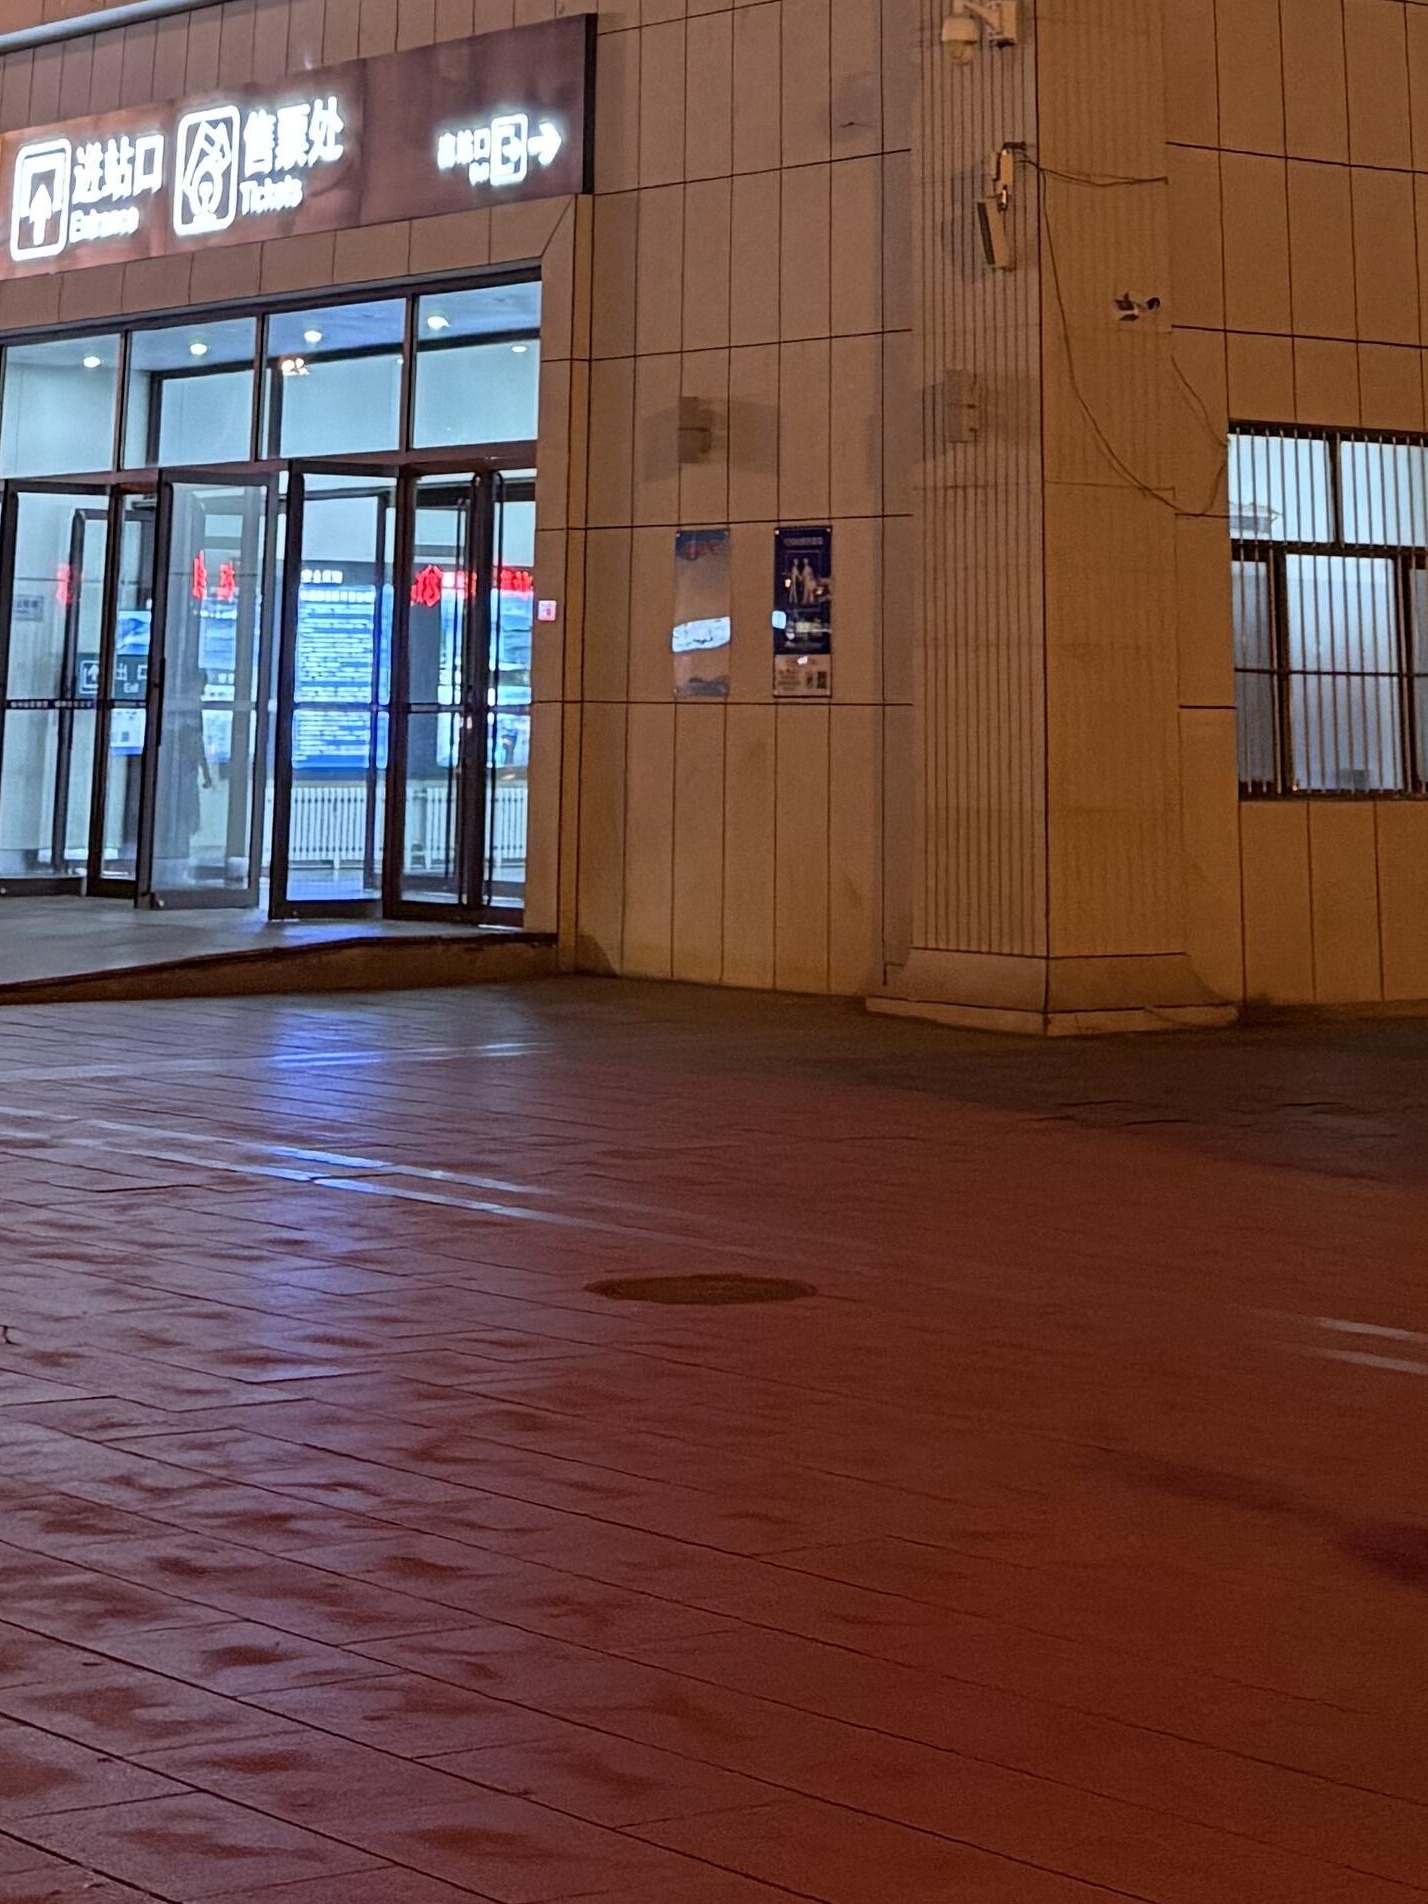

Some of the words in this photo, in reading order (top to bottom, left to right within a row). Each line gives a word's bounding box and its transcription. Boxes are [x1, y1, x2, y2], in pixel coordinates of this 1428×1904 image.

[72, 134, 164, 205] 进站口
[243, 95, 344, 178] 售票处
